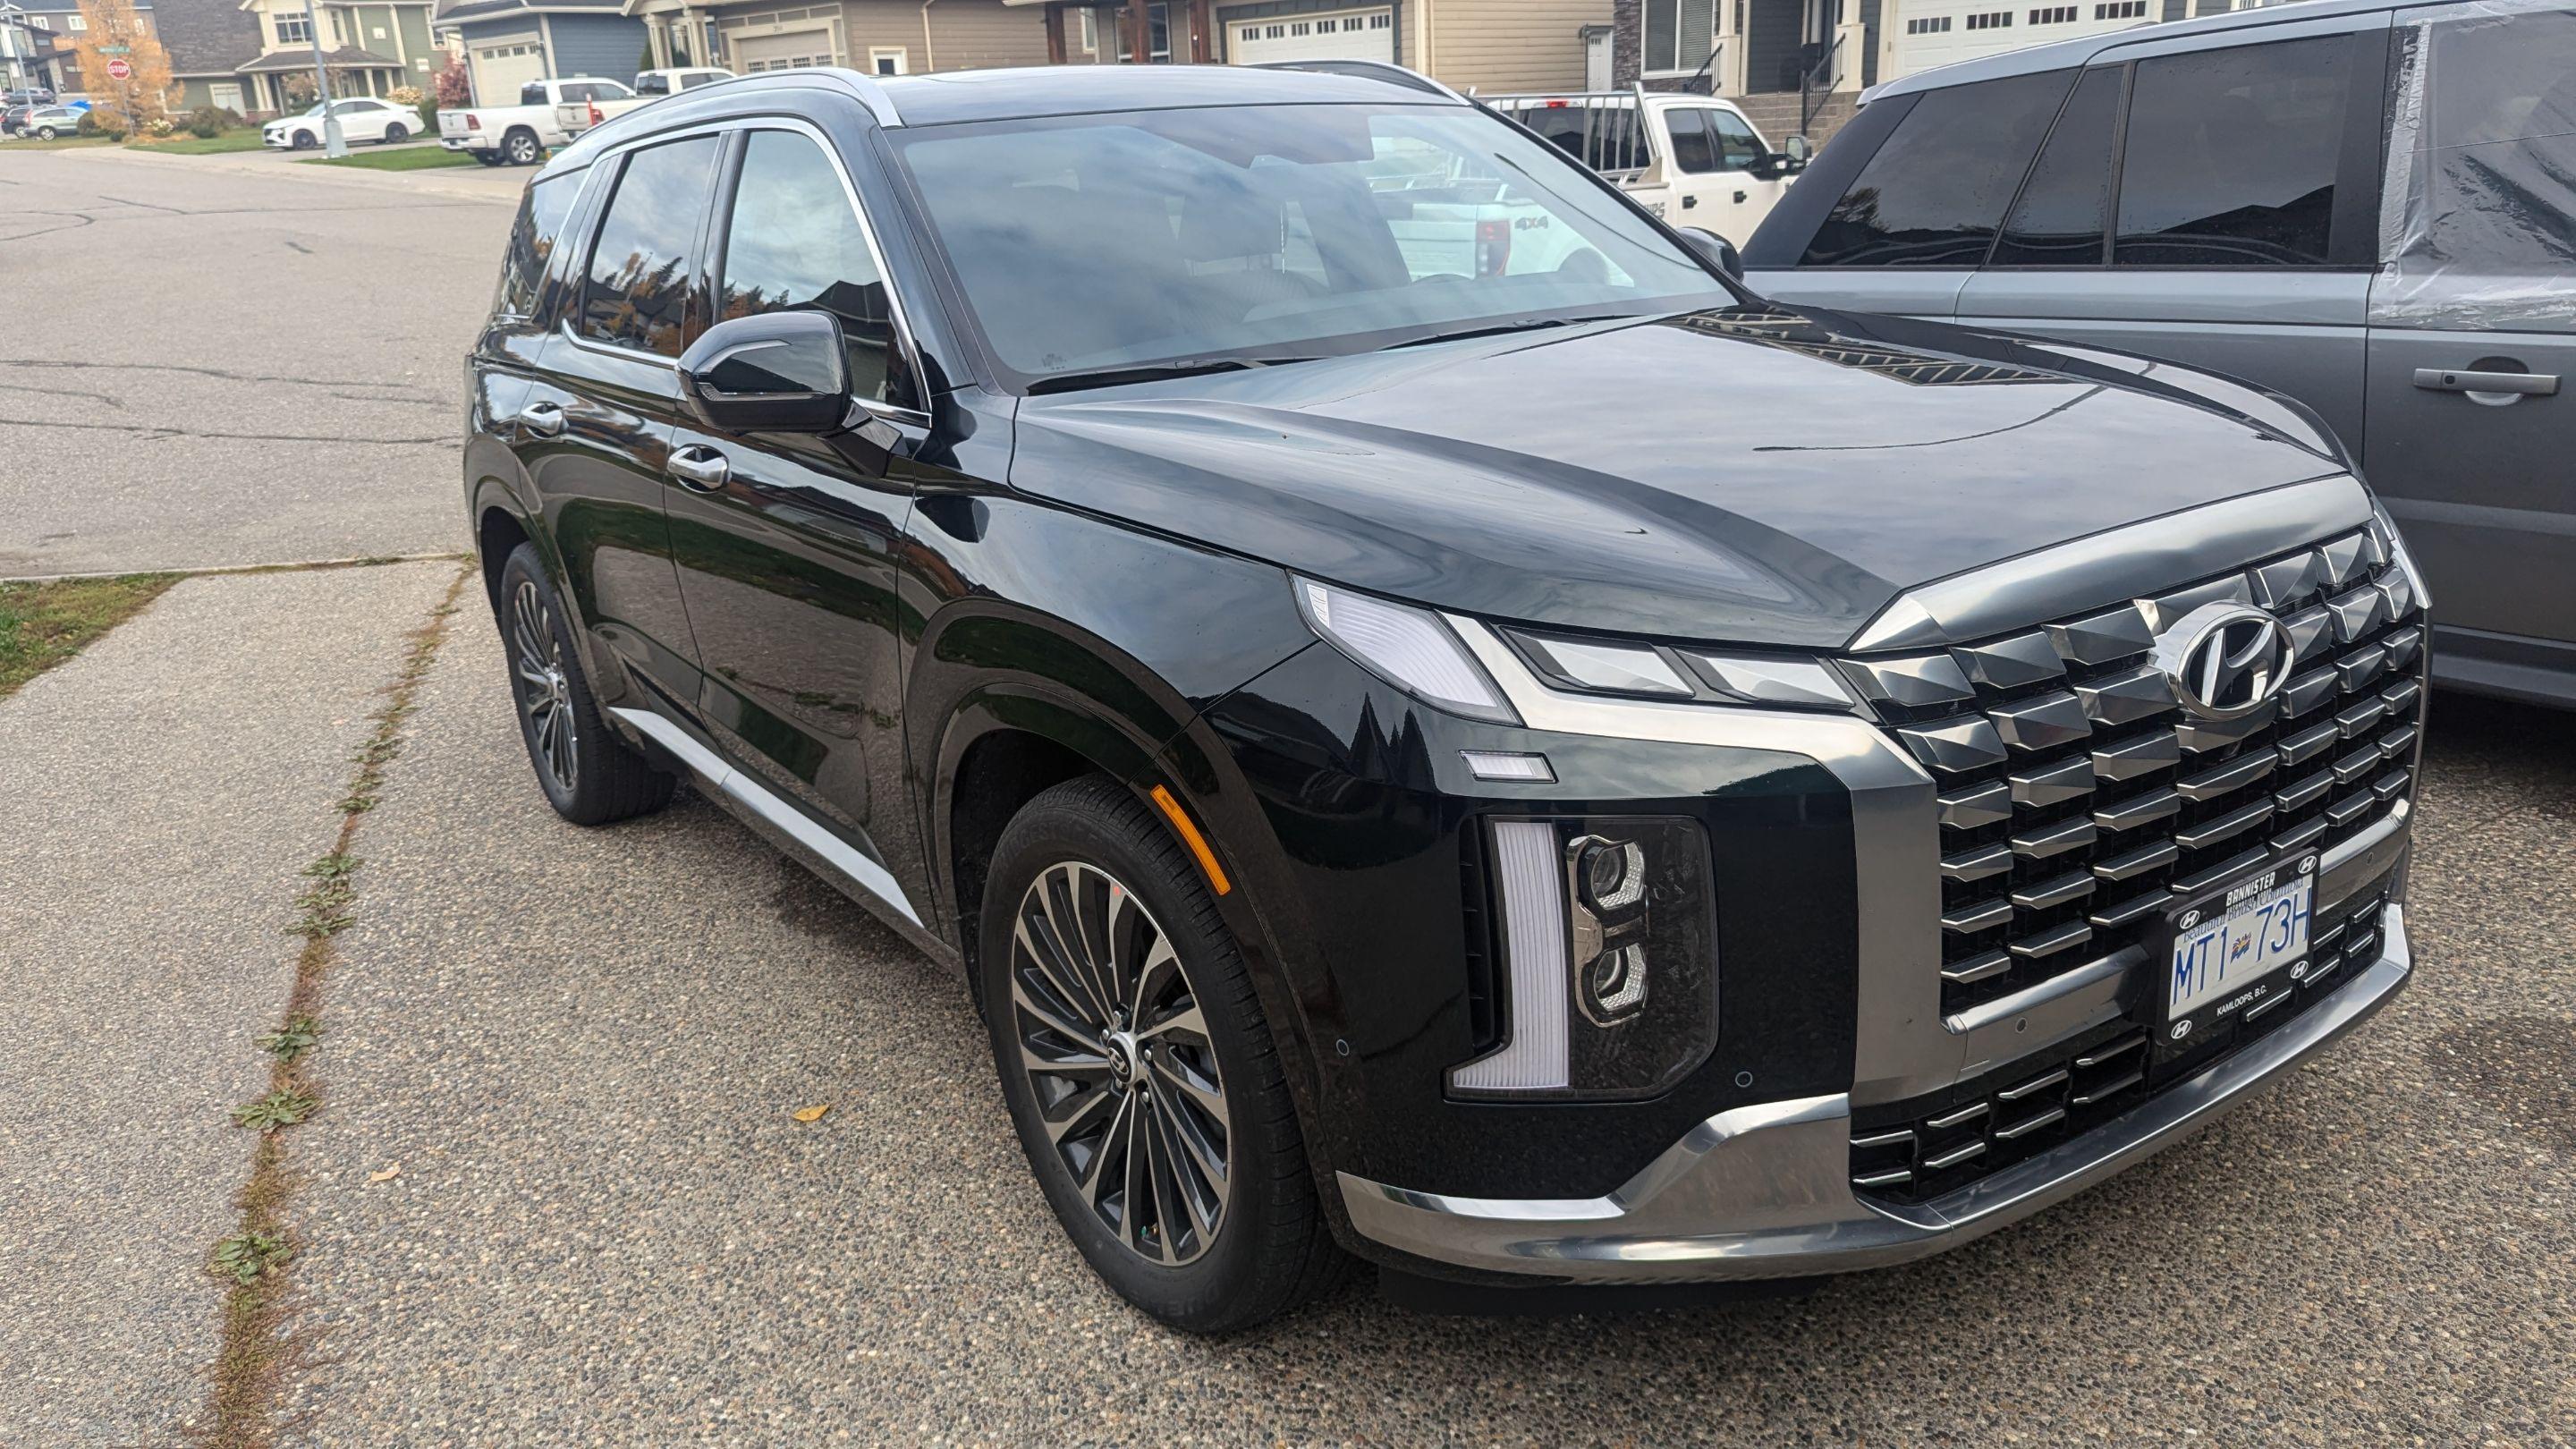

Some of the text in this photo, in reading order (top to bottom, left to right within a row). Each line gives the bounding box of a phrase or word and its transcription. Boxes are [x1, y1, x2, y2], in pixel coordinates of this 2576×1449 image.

[108, 64, 130, 74] STOP
[2226, 871, 2275, 907] BANNISTER
[2256, 886, 2311, 963] 73H
[2216, 991, 2253, 1017] KAMLOOPS,
